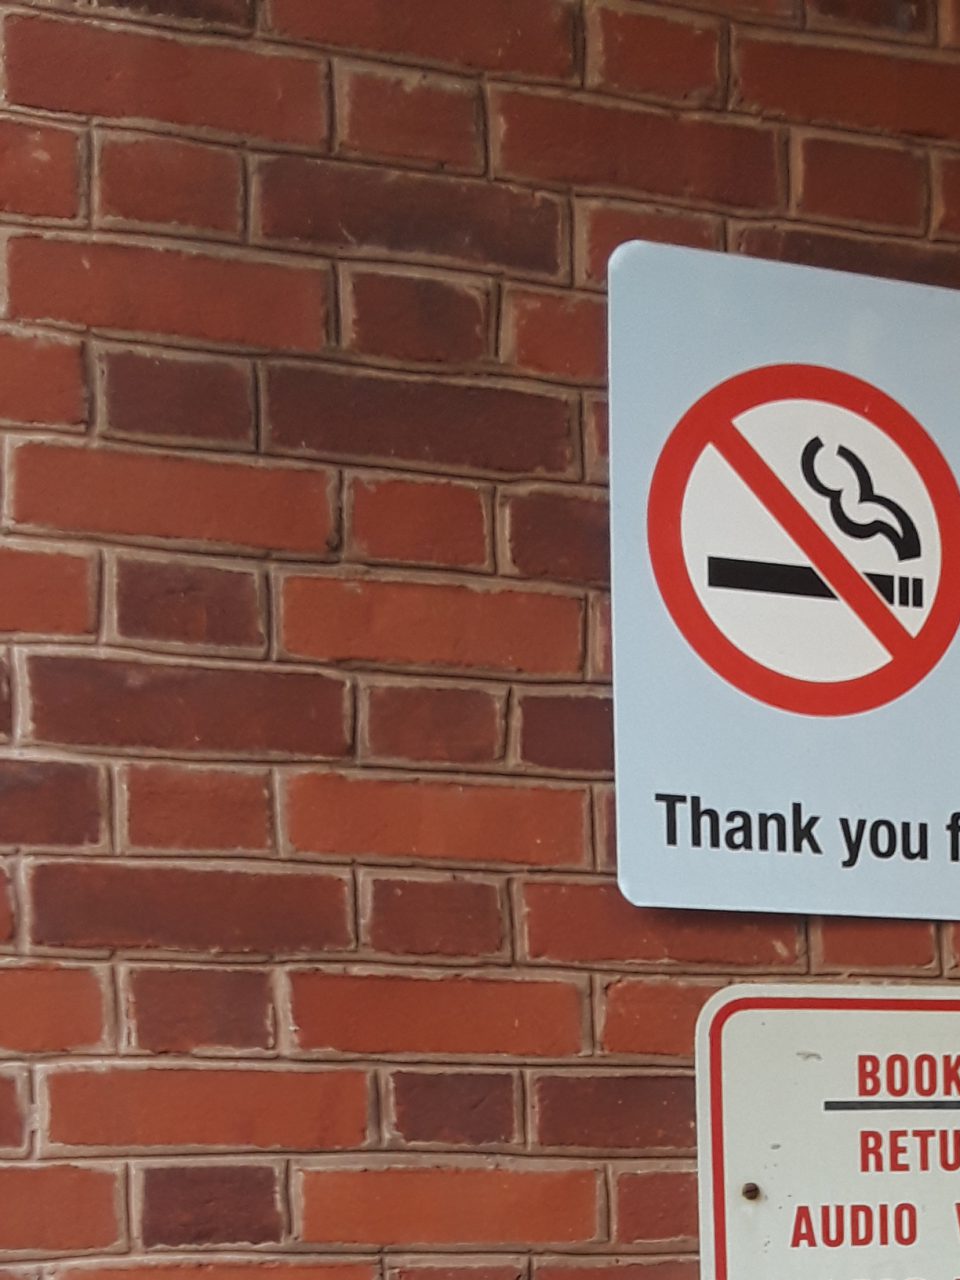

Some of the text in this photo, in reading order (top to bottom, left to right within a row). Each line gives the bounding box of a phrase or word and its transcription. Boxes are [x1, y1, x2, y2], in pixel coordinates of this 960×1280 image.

[655, 792, 822, 854] Thank
[840, 817, 929, 868] you
[791, 1202, 918, 1248] AUDIO
